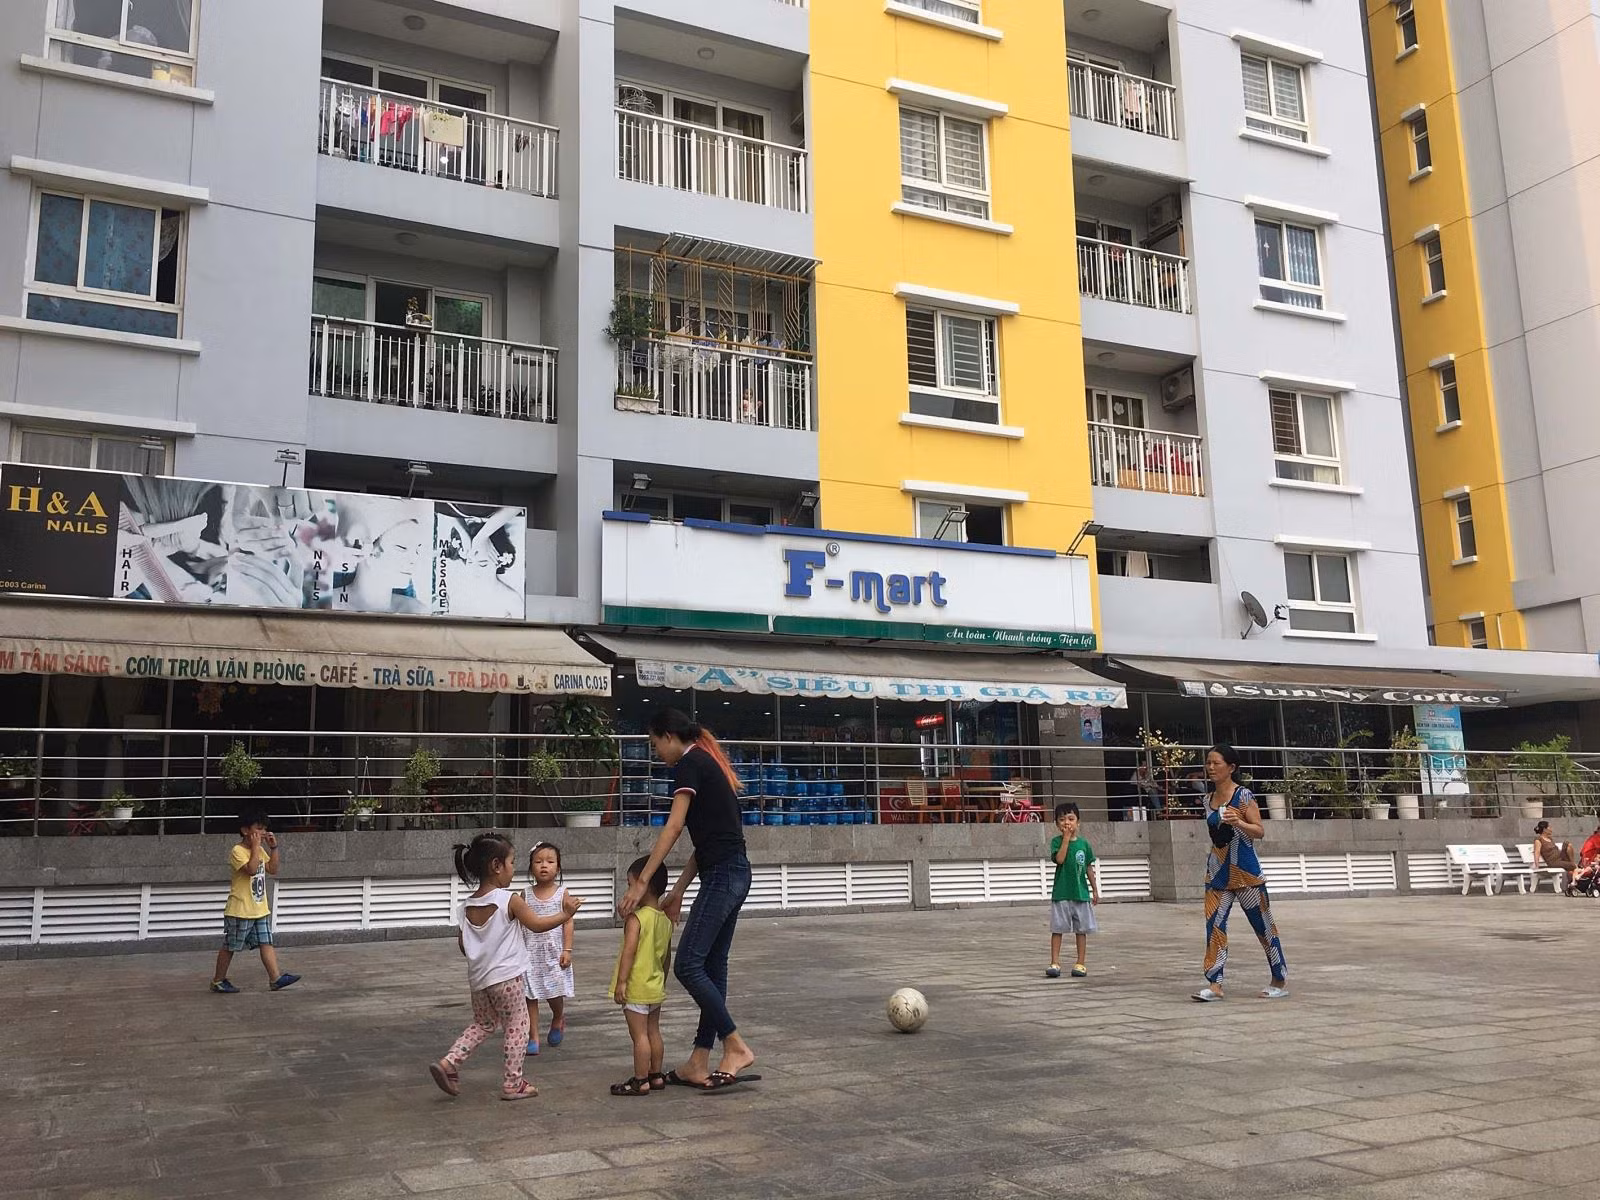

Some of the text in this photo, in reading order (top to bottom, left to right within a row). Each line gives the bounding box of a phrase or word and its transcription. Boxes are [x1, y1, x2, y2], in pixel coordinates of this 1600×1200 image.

[6, 485, 109, 518] H & A
[46, 519, 108, 535] NAILS
[21, 581, 46, 590] Carina
[121, 548, 132, 591] HAIR
[313, 550, 323, 601] NAILS
[438, 539, 449, 608] MASSAGE
[783, 548, 947, 613] F-mart
[946, 627, 964, 639] An
[965, 629, 986, 640] toàn
[992, 630, 1024, 642] Nhanh
[1026, 632, 1052, 645] chóng
[1058, 633, 1079, 647] Tiện
[63, 649, 110, 673] SÁNG
[125, 655, 163, 676] CƠM
[168, 656, 210, 677] TRƯA
[216, 656, 248, 679] VĂN
[253, 658, 306, 682] PHÒNG
[320, 662, 358, 684] CAFÉ
[372, 664, 401, 686] TRÀ
[406, 665, 435, 687] SỮA
[447, 667, 475, 688] TRÀ
[480, 668, 509, 689] ĐÀO
[554, 673, 584, 690] CARINA
[585, 675, 608, 691] C.015
[767, 677, 872, 693] SIÊU
[889, 683, 963, 698] THỊ
[1383, 690, 1501, 704] Coffee
